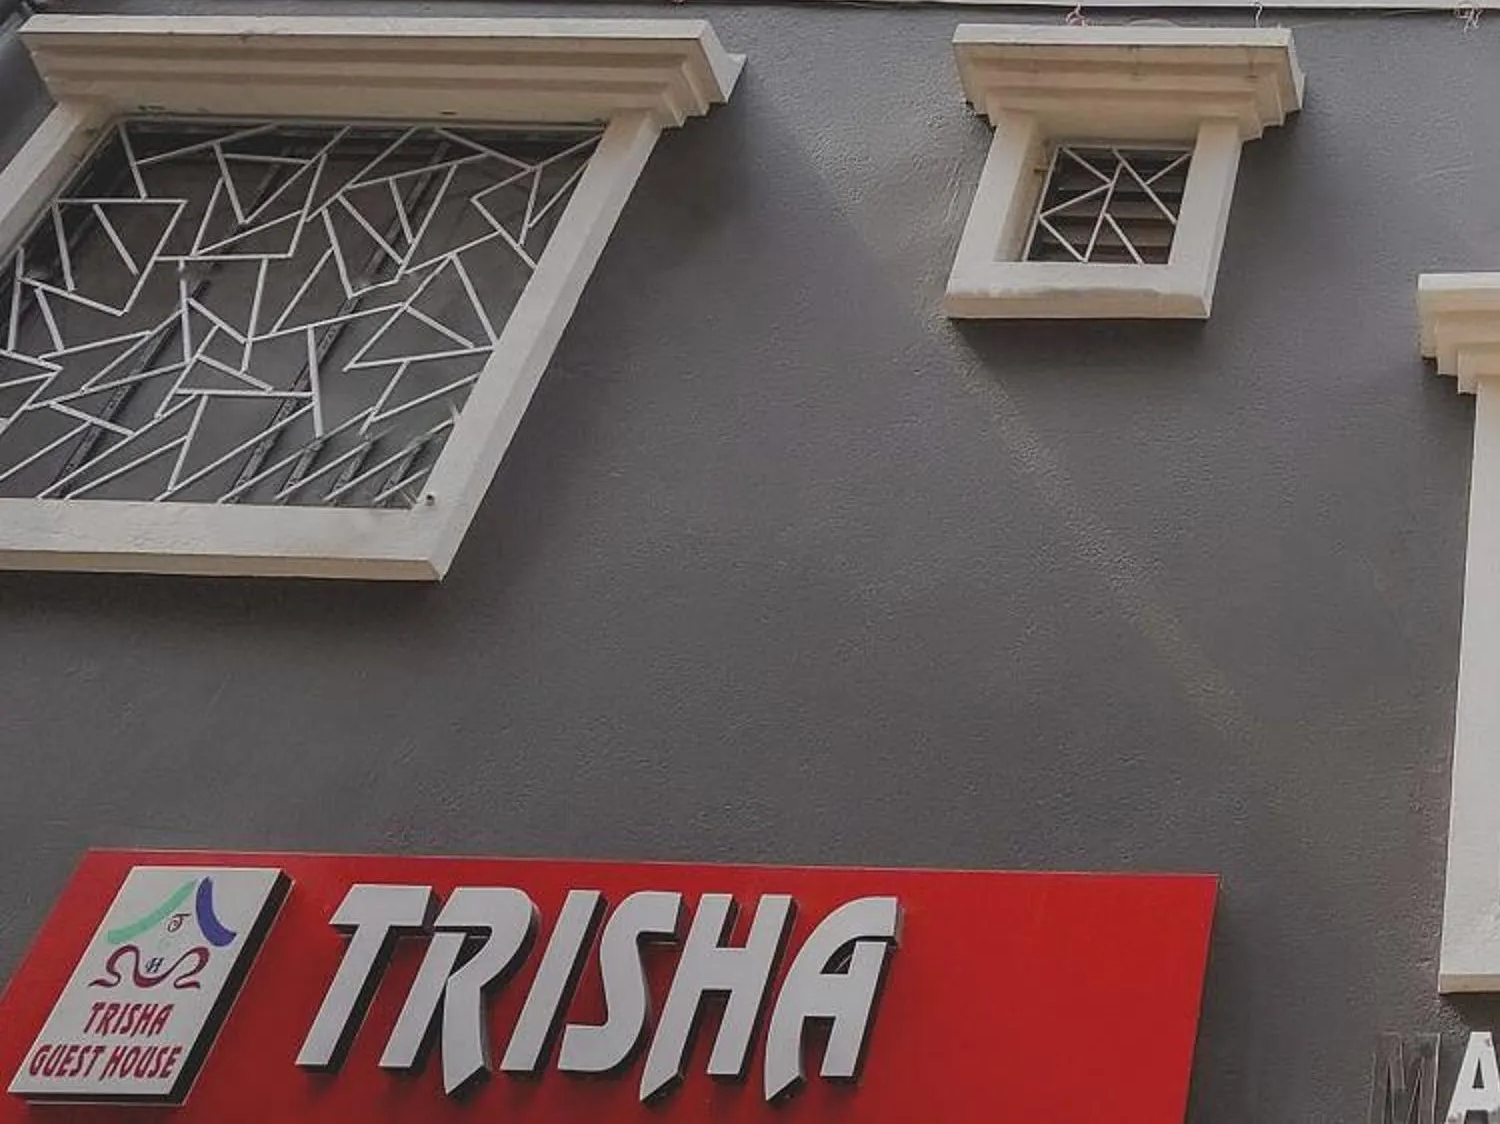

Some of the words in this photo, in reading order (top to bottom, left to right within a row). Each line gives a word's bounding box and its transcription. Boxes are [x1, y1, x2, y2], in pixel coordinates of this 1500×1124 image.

[295, 883, 898, 1101] TRISHA
[83, 1002, 174, 1036] TRISHA
[29, 1044, 104, 1077] GUEST
[99, 1045, 183, 1082] HOUSE
